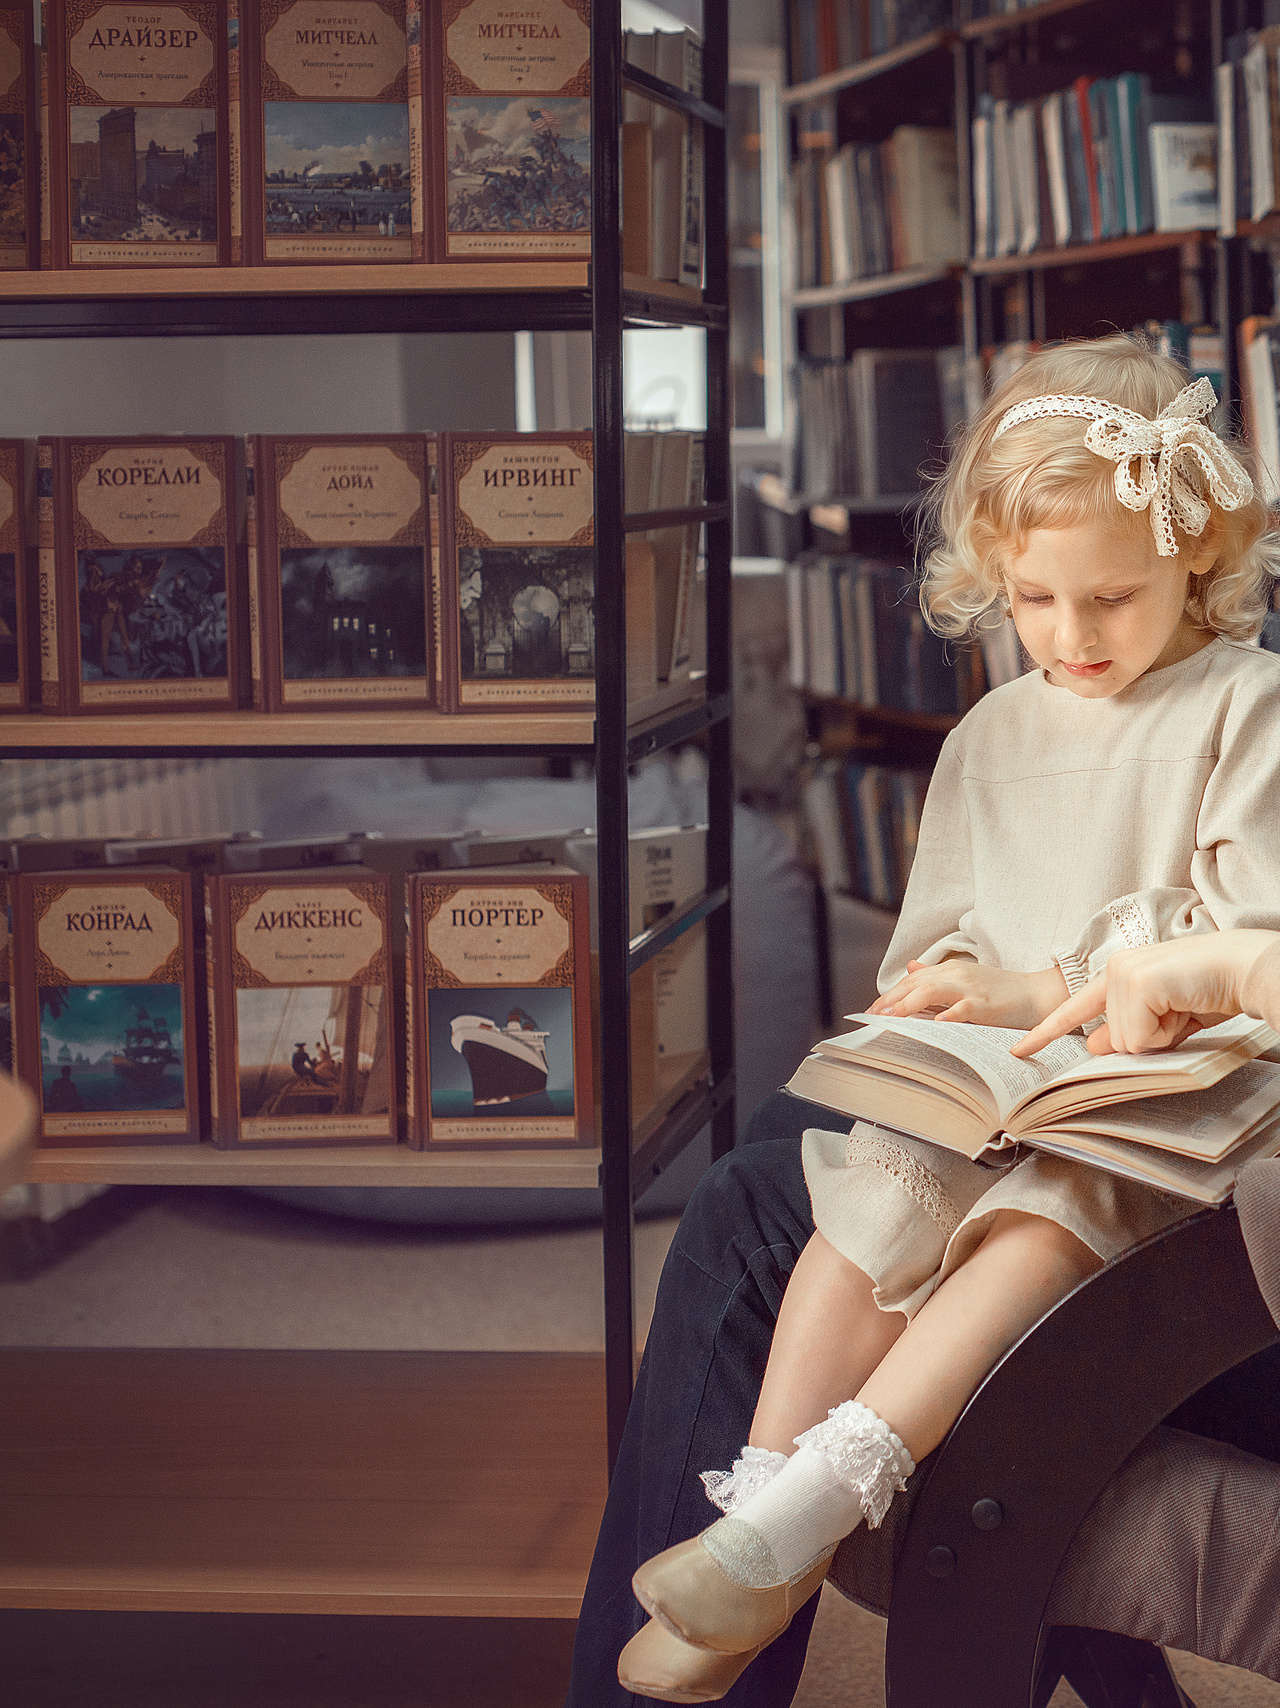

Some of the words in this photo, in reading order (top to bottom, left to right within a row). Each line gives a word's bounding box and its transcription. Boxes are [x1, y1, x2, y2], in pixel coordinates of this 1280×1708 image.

[126, 16, 161, 24] ТЕОДОР
[89, 26, 198, 50] ДРАЙЗЕР
[294, 29, 379, 45] МИТЧЕЛЛ
[478, 24, 561, 39] МИТЧЕЛЛ
[97, 70, 153, 80] Американская
[96, 466, 201, 486] КОРЕЛЛИ
[327, 473, 374, 492] ДОЙЛ
[483, 468, 580, 487] ИРВИНГ
[66, 912, 153, 933] КОНРАД
[254, 908, 362, 932] ДИККЕНС
[450, 908, 543, 927] ПОРТЕР
